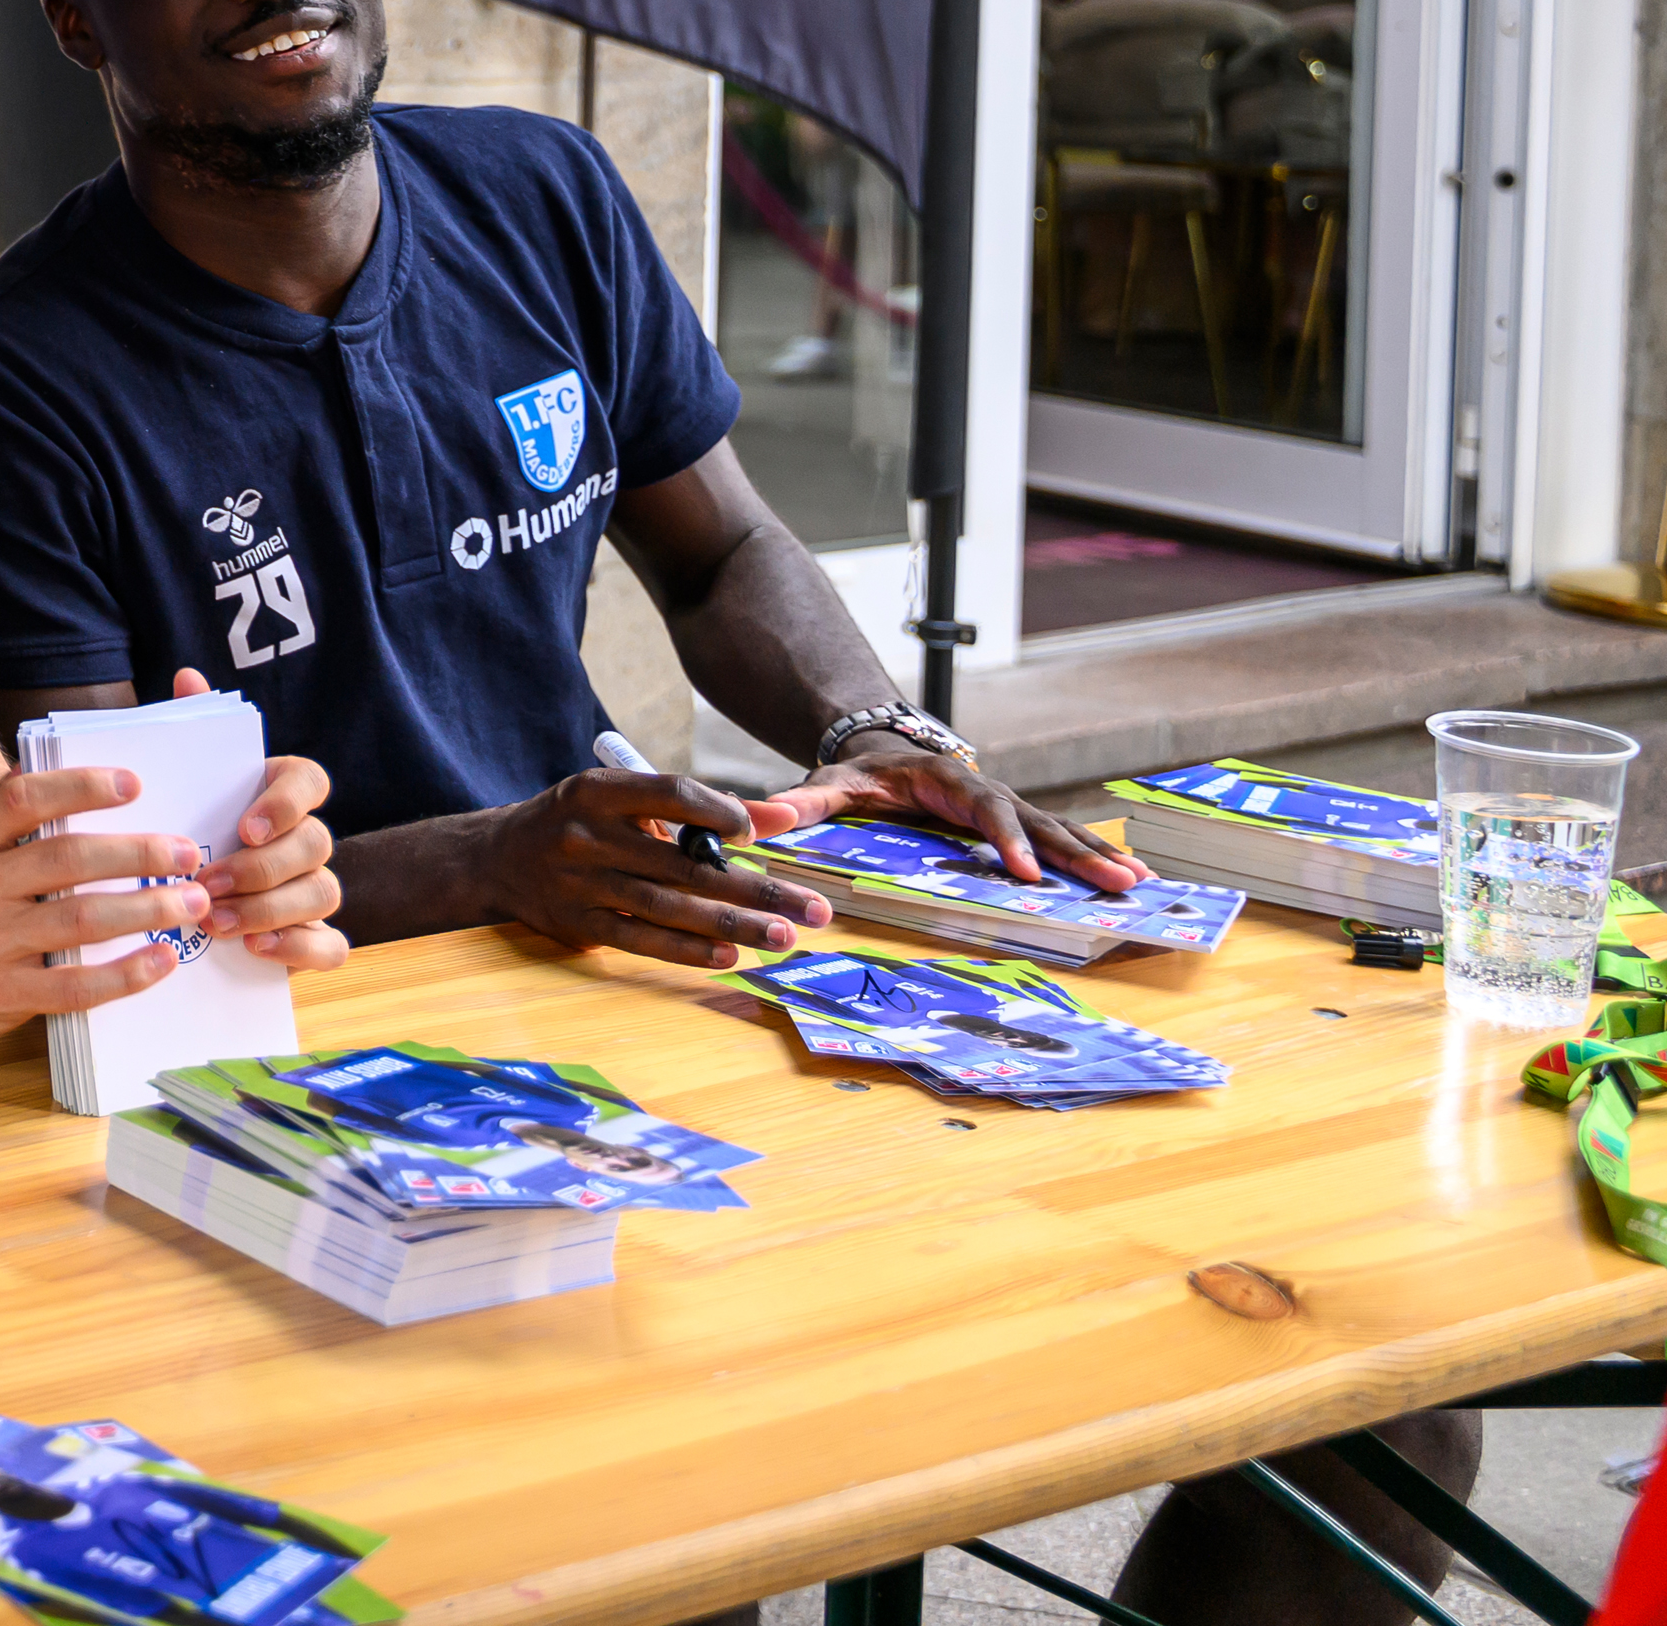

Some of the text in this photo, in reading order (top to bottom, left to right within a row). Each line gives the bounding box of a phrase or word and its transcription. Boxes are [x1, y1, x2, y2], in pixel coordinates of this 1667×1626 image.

[522, 419, 582, 485] MAGDEBURG
[211, 526, 290, 581] hummel
[214, 553, 317, 670] 29
